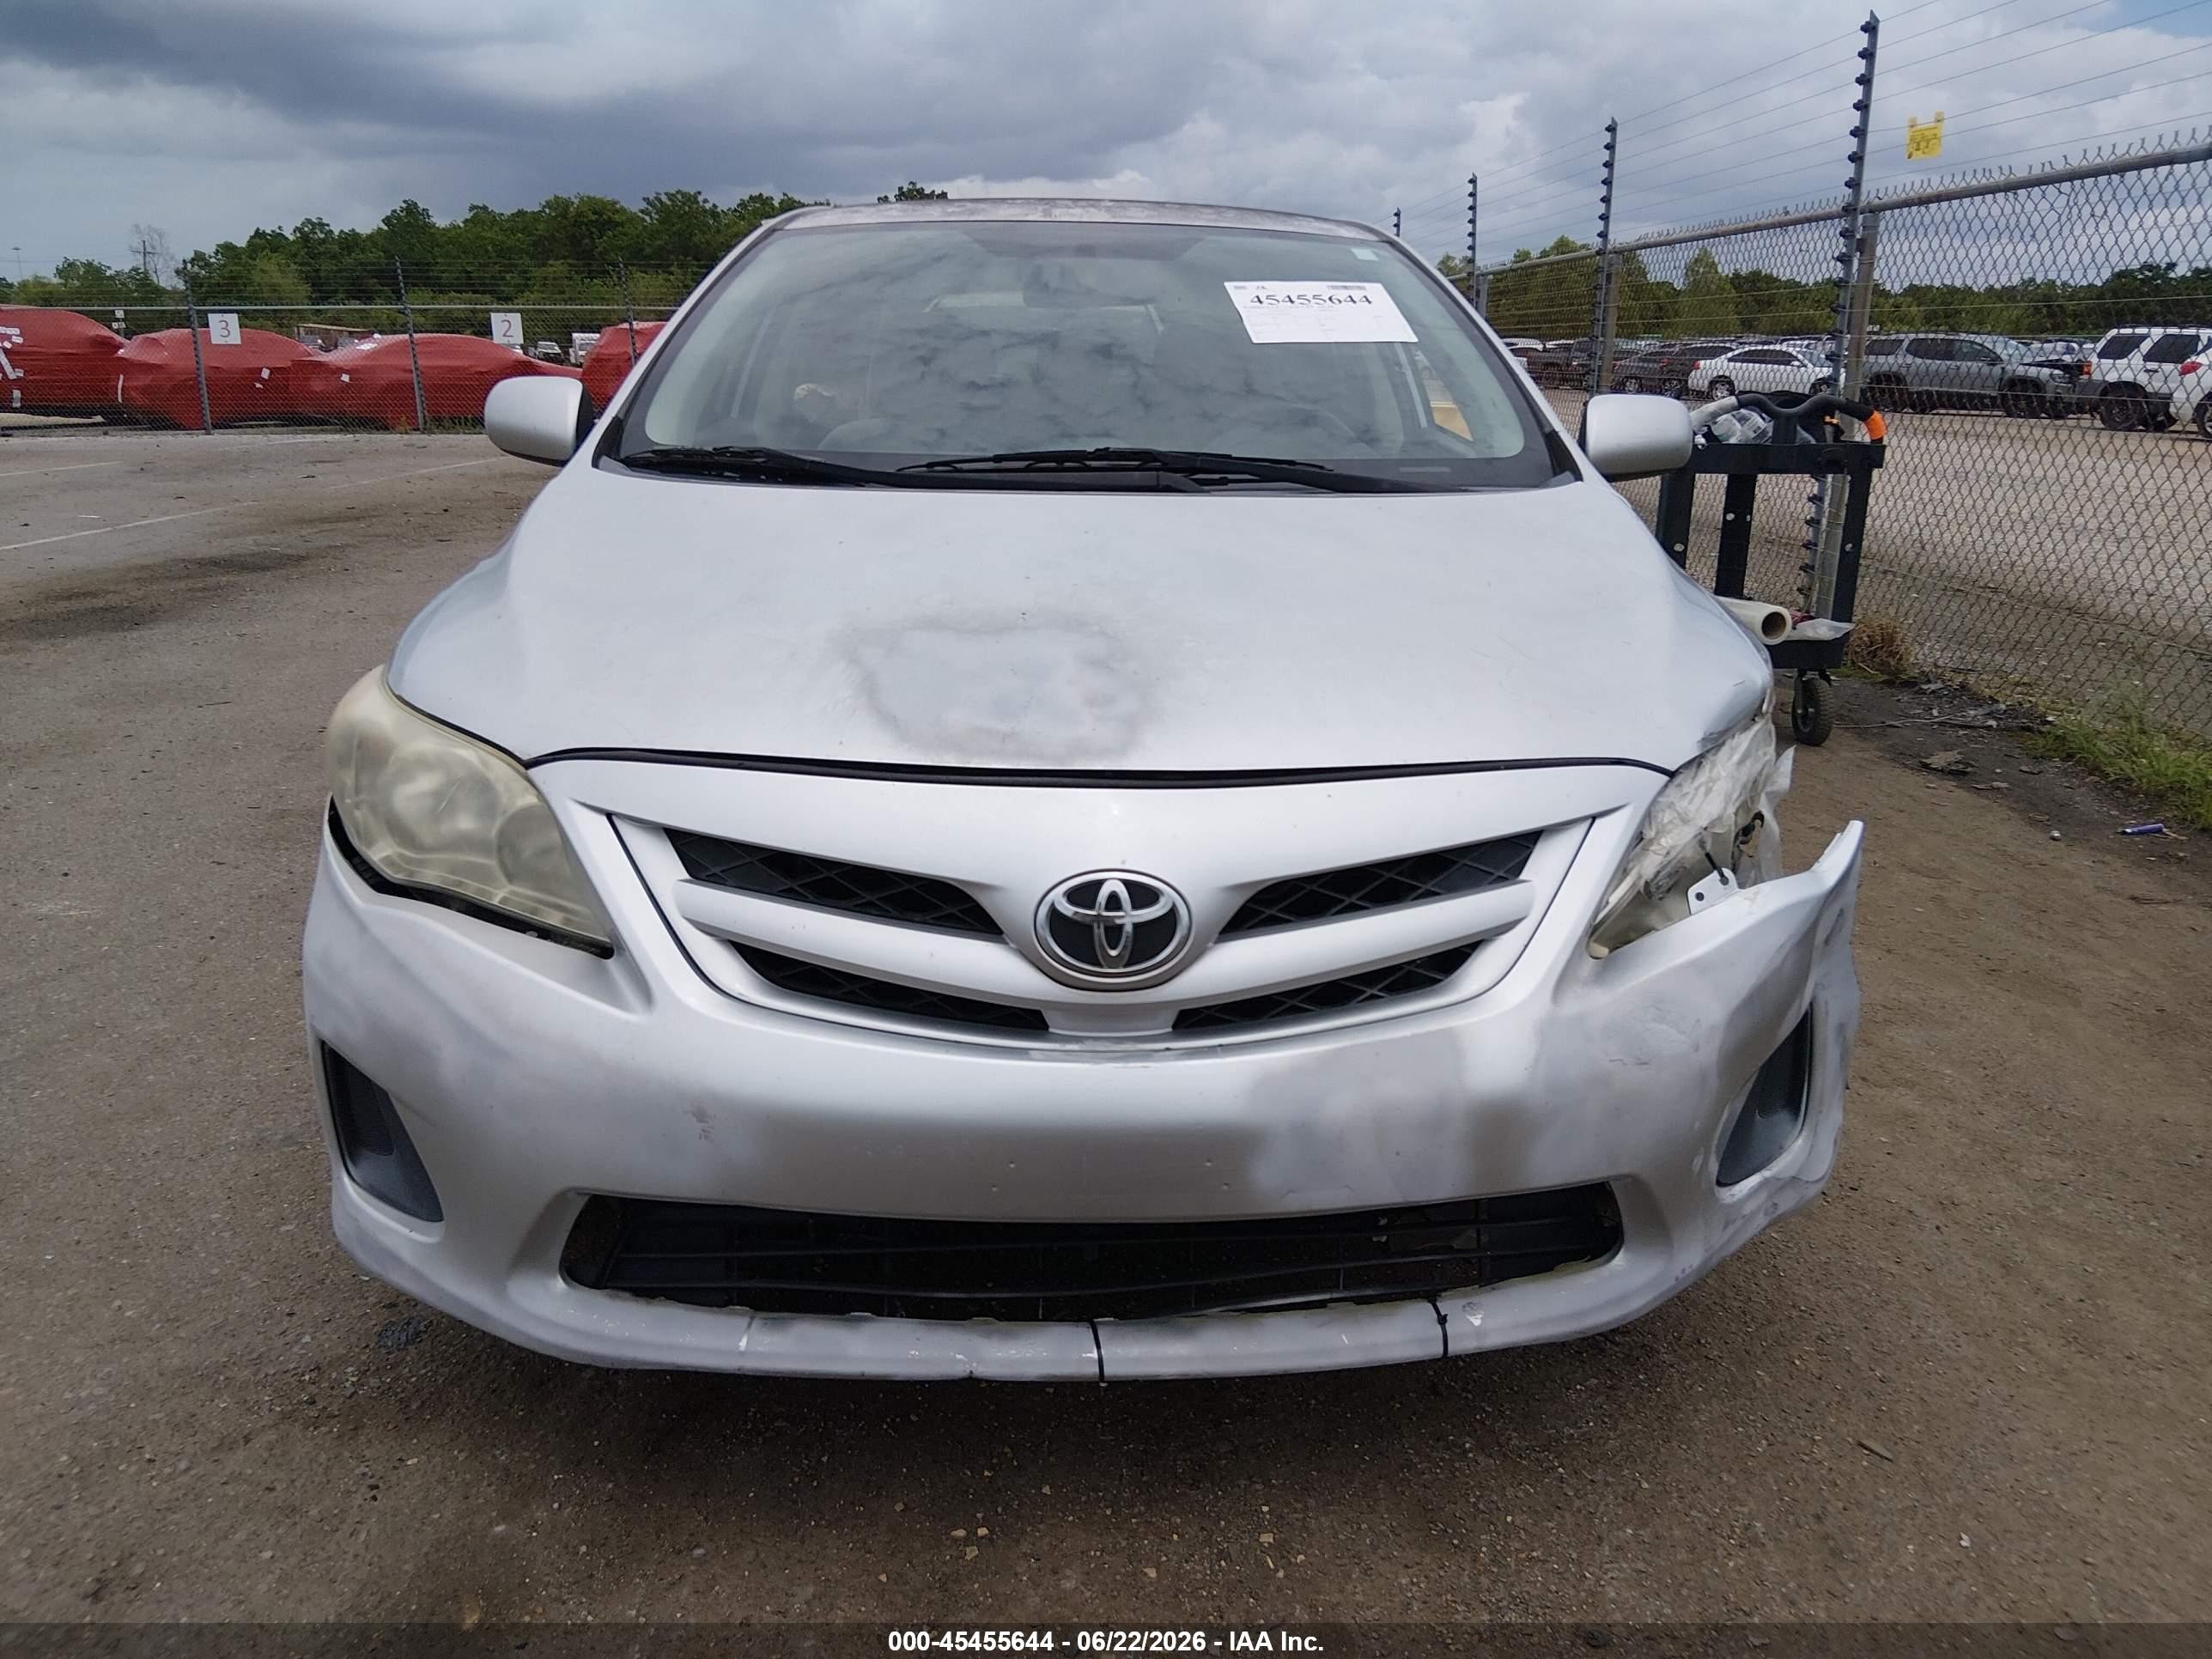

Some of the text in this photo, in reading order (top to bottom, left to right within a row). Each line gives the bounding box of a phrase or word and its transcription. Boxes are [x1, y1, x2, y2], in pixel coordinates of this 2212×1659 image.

[1250, 295, 1372, 305] 45455644
[218, 320, 230, 337] 3
[501, 319, 514, 337] 2
